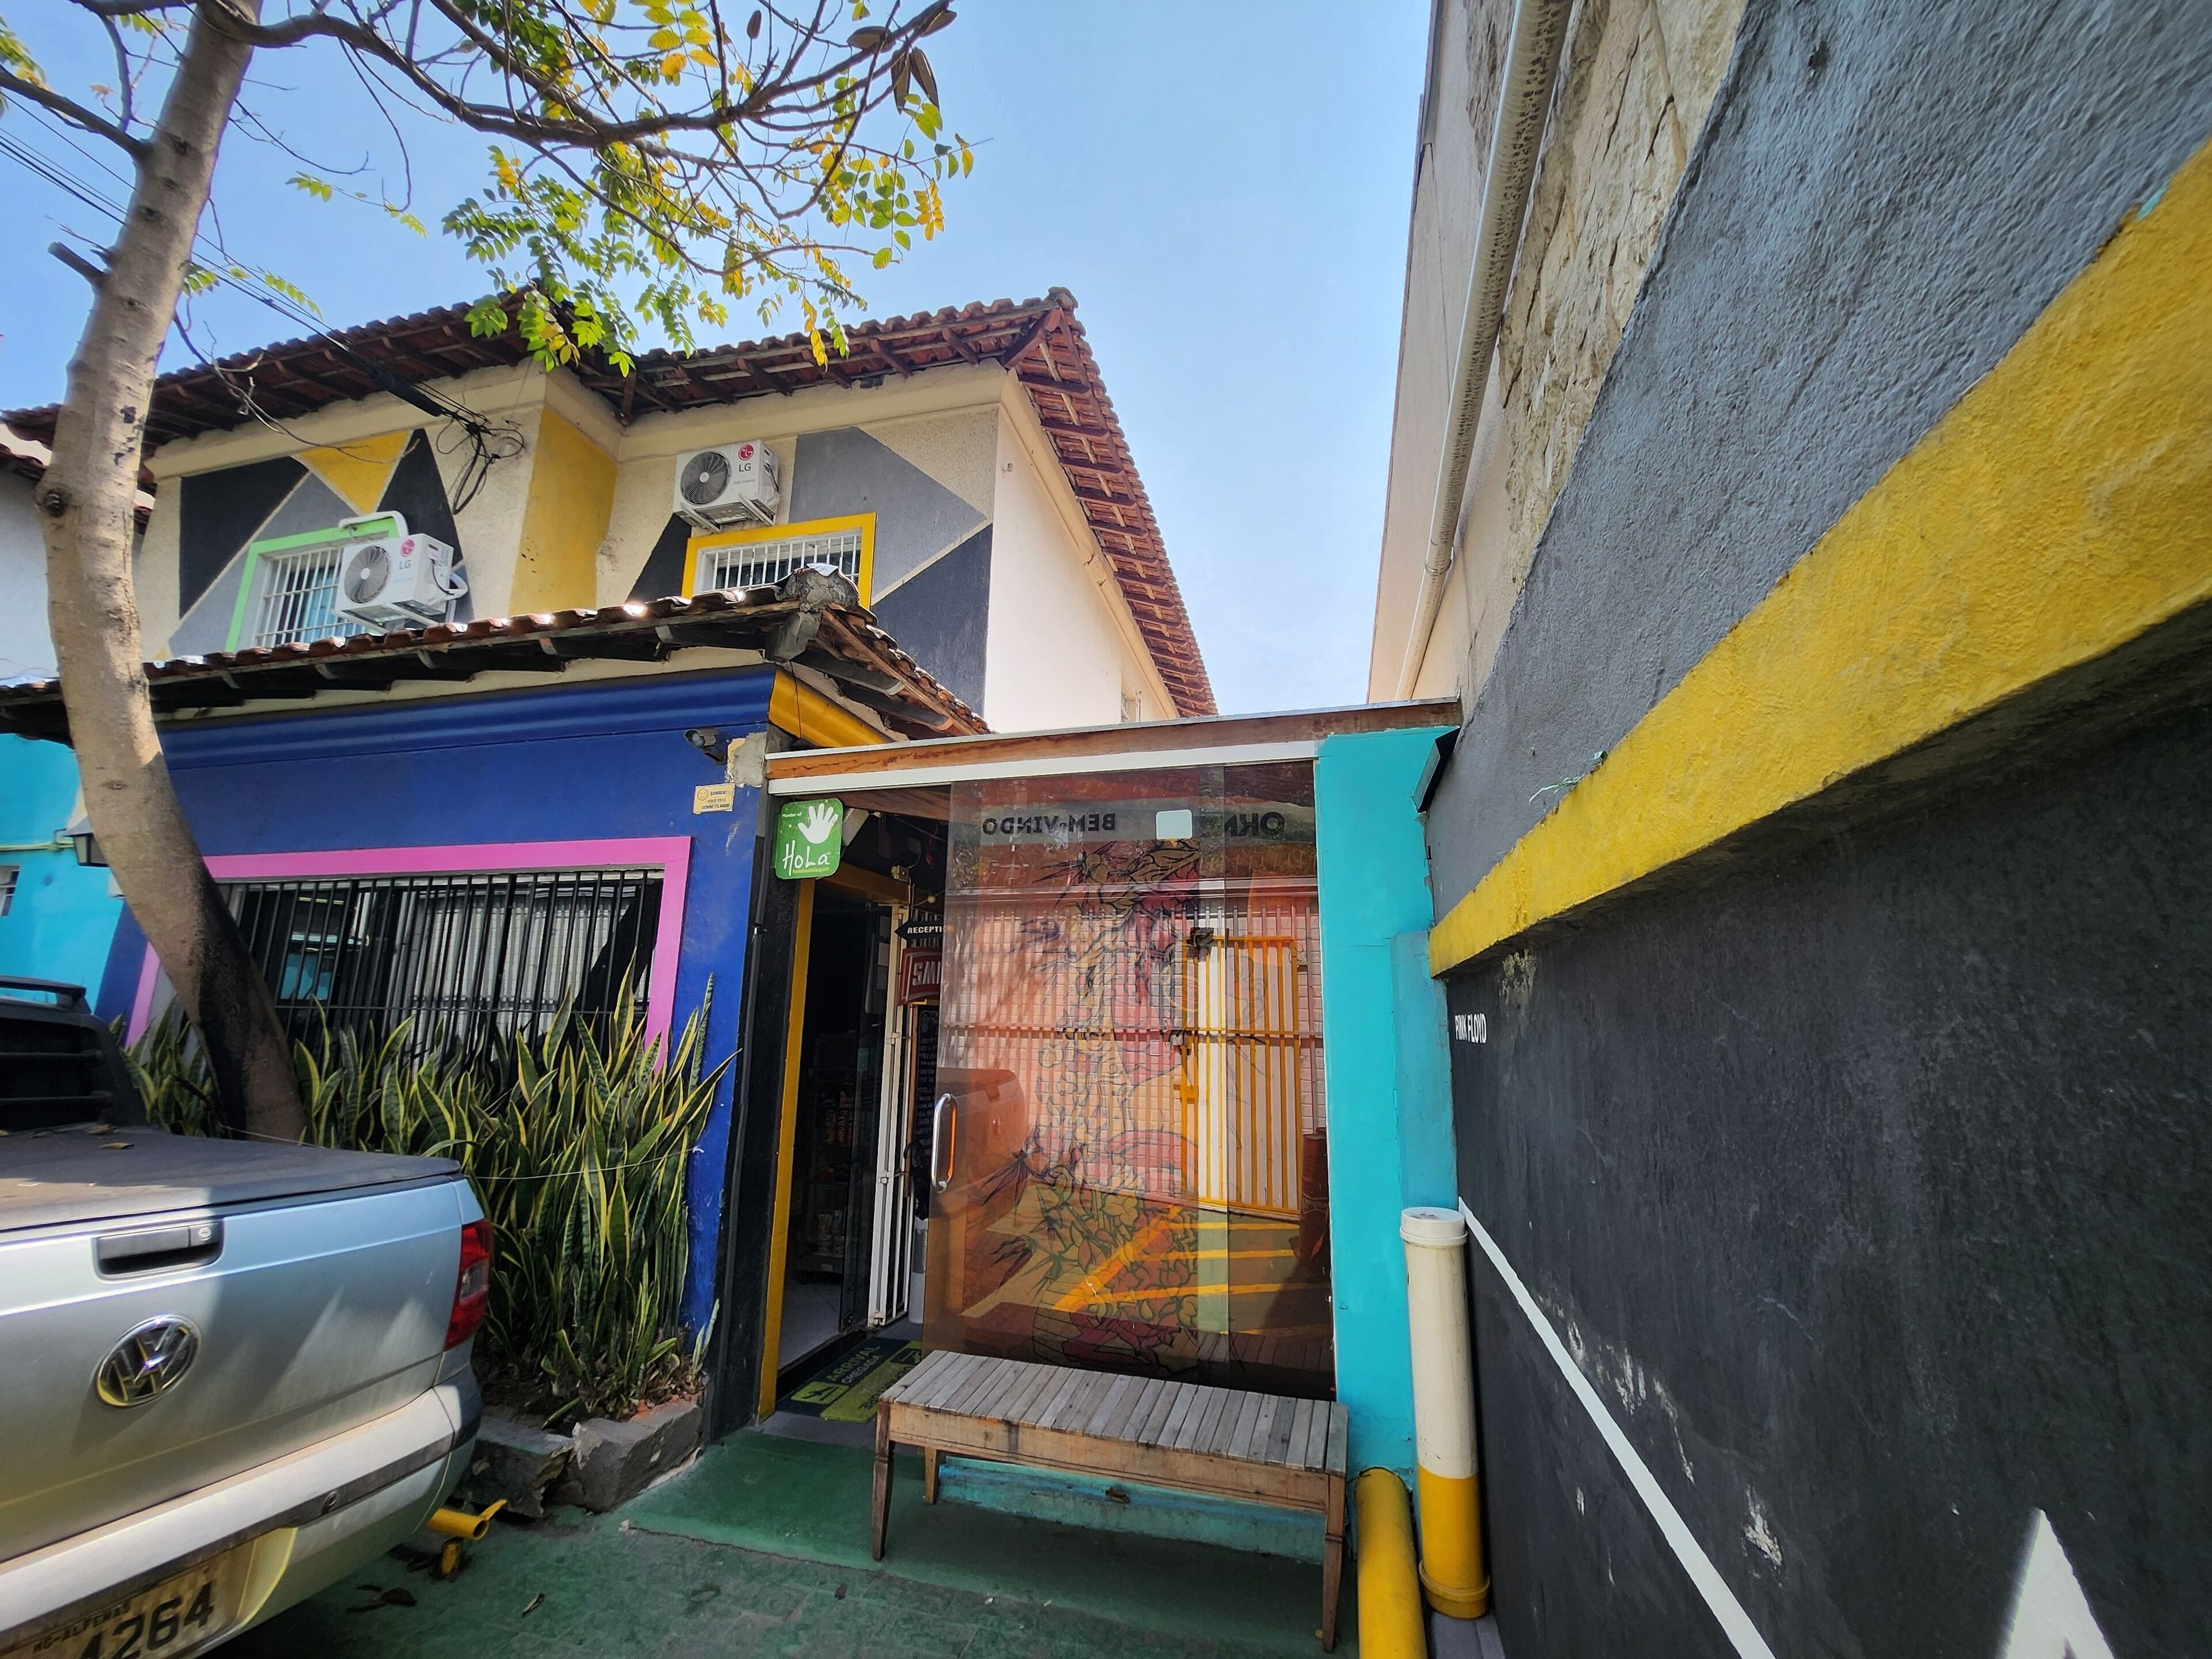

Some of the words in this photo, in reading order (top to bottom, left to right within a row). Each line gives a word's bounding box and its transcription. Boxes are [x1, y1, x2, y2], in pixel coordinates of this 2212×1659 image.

[738, 463, 752, 472] LG
[399, 560, 411, 570] LG
[907, 926, 946, 934] RECEPTI
[1455, 1014, 1467, 1041] PINK
[1467, 1013, 1487, 1044] FLOYD
[827, 1346, 881, 1381] ARRIVAL
[841, 1355, 882, 1383] CHEGADA
